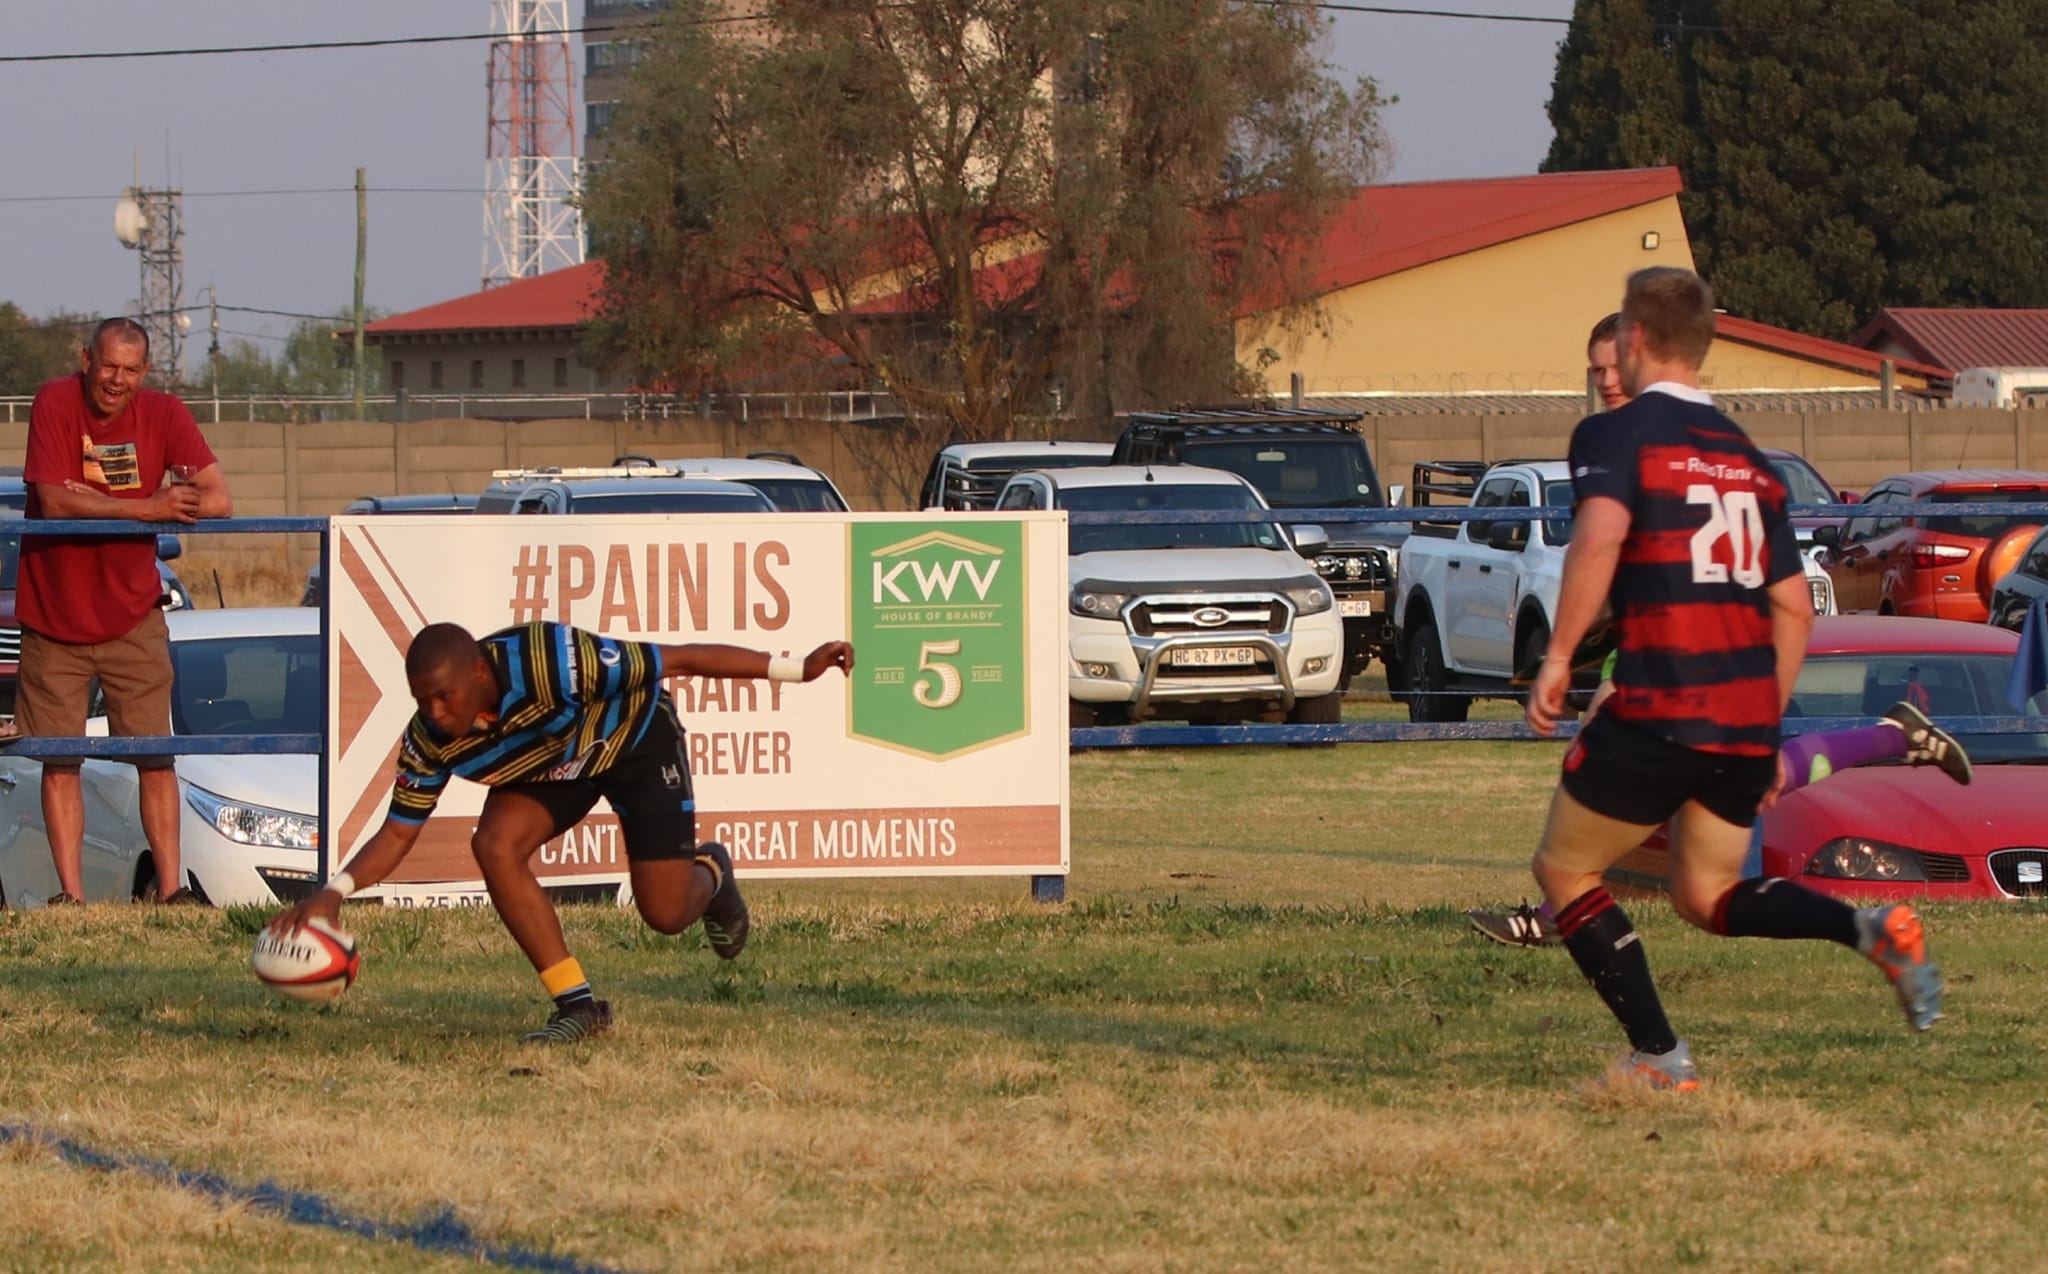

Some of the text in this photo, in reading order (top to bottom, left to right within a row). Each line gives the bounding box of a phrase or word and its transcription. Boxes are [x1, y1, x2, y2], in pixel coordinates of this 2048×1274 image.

[1686, 484, 1765, 589] 20
[509, 540, 791, 633] #PAIN IS
[873, 559, 1001, 603] KWV
[881, 610, 994, 621] HOUSE OF BRANDY
[874, 639, 1002, 709] AGED 5 YEARS
[1175, 649, 1252, 663] HC 82 PX GP
[691, 731, 792, 775] REVER
[714, 821, 799, 860] GREAT
[813, 818, 957, 859] MOMENTS
